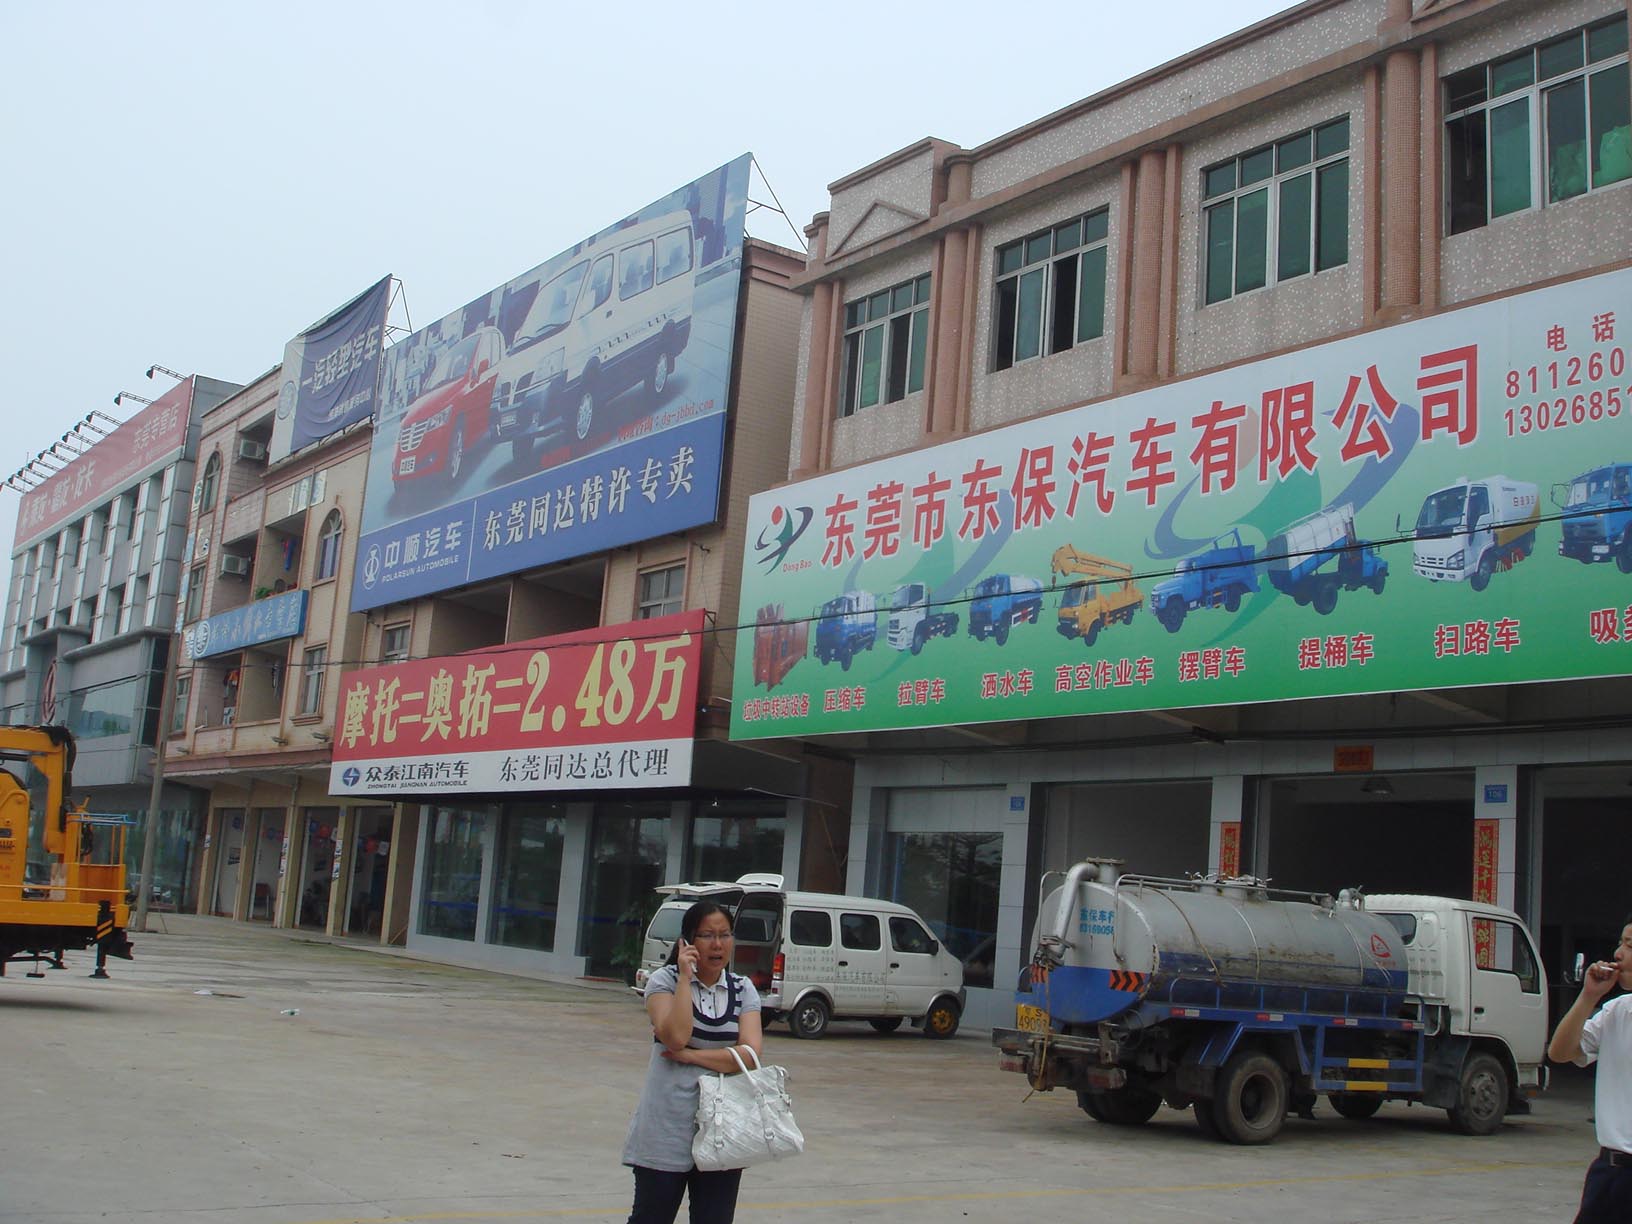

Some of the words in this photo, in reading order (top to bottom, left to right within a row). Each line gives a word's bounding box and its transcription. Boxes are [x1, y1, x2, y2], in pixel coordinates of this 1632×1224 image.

[1546, 311, 1616, 352] 电话
[820, 342, 1479, 568] 东莞市东保汽车有限公司
[384, 520, 464, 569] 中顺汽车
[483, 446, 695, 551] 东莞同达特许专卖
[416, 554, 459, 573] AUTOMOBILE
[1299, 632, 1375, 671] 提桶车
[1434, 617, 1521, 658] 扫路车
[1055, 656, 1154, 693] 高空作业车
[1178, 647, 1246, 682] 摆臂车
[823, 686, 866, 712] 压缩车
[897, 678, 945, 706] 拉臂车
[981, 669, 1034, 698] 洒水车
[742, 693, 810, 721] 垃圾中转站设备
[365, 760, 470, 783] 众泰江南汽车
[499, 748, 669, 782] 东莞同达总代理
[429, 780, 468, 788] AUTOMOBILE
